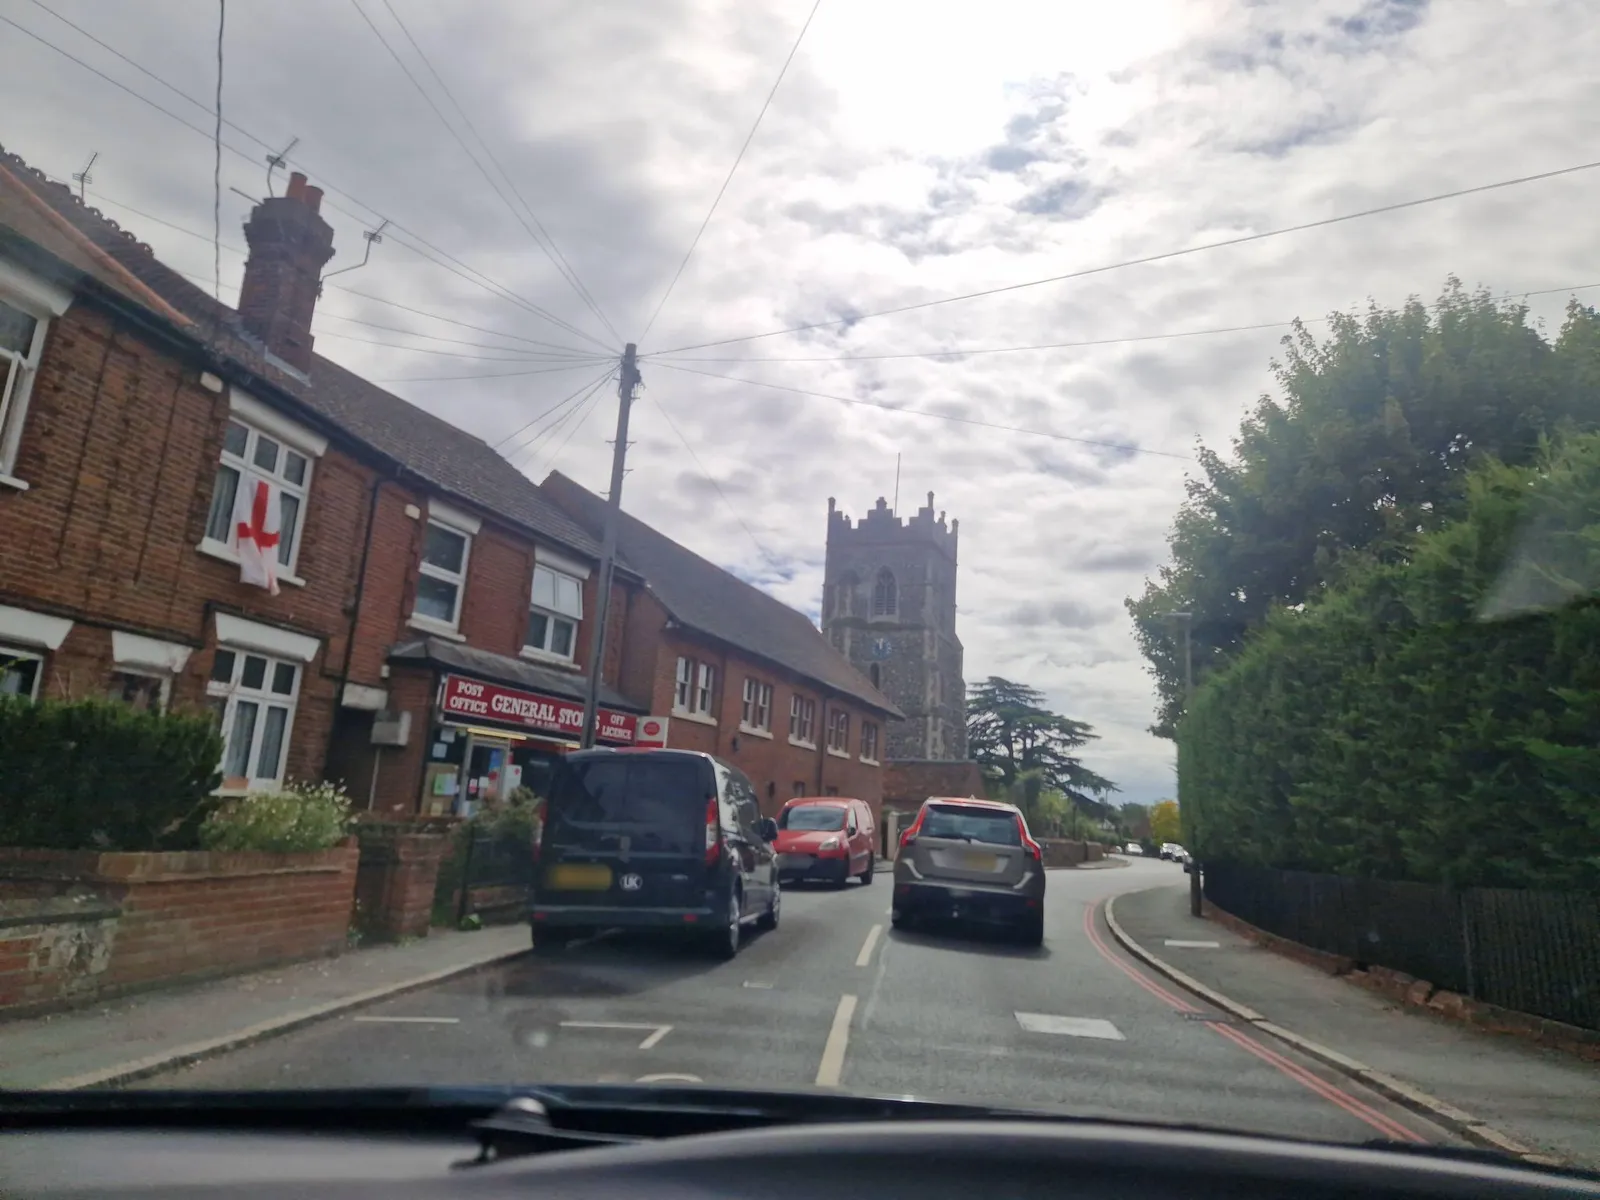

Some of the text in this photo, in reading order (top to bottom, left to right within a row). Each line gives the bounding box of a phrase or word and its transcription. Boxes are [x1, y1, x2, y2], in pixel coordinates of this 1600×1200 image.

[457, 681, 484, 697] POST
[449, 696, 487, 714] OFFICE
[491, 694, 556, 722] GENERAL
[558, 708, 600, 730] STOS
[610, 714, 625, 727] OFF
[602, 725, 632, 740] LICENCE
[623, 876, 639, 889] UK
